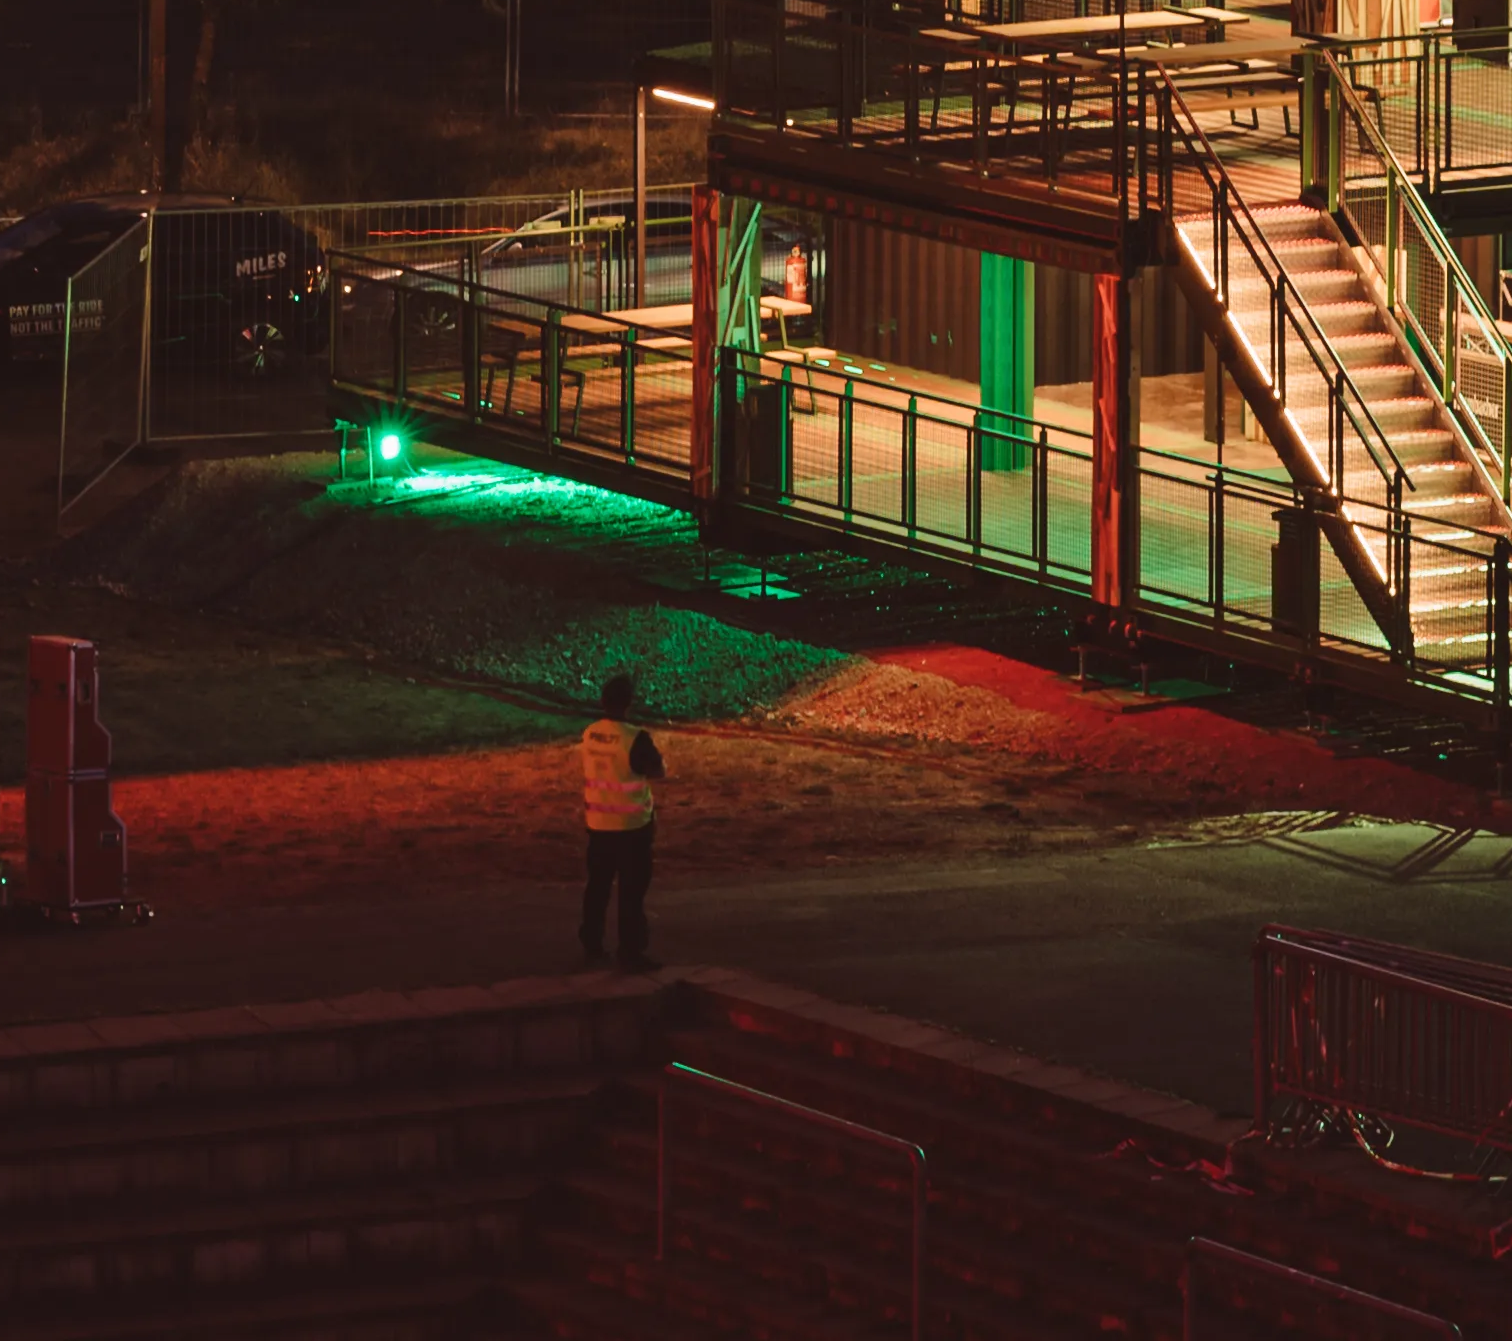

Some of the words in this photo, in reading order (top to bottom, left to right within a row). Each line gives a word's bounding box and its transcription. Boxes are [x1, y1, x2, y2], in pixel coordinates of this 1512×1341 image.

[236, 251, 287, 277] MILES
[9, 305, 29, 317] PAY
[32, 303, 52, 316] FOR
[78, 299, 103, 314] RIDE
